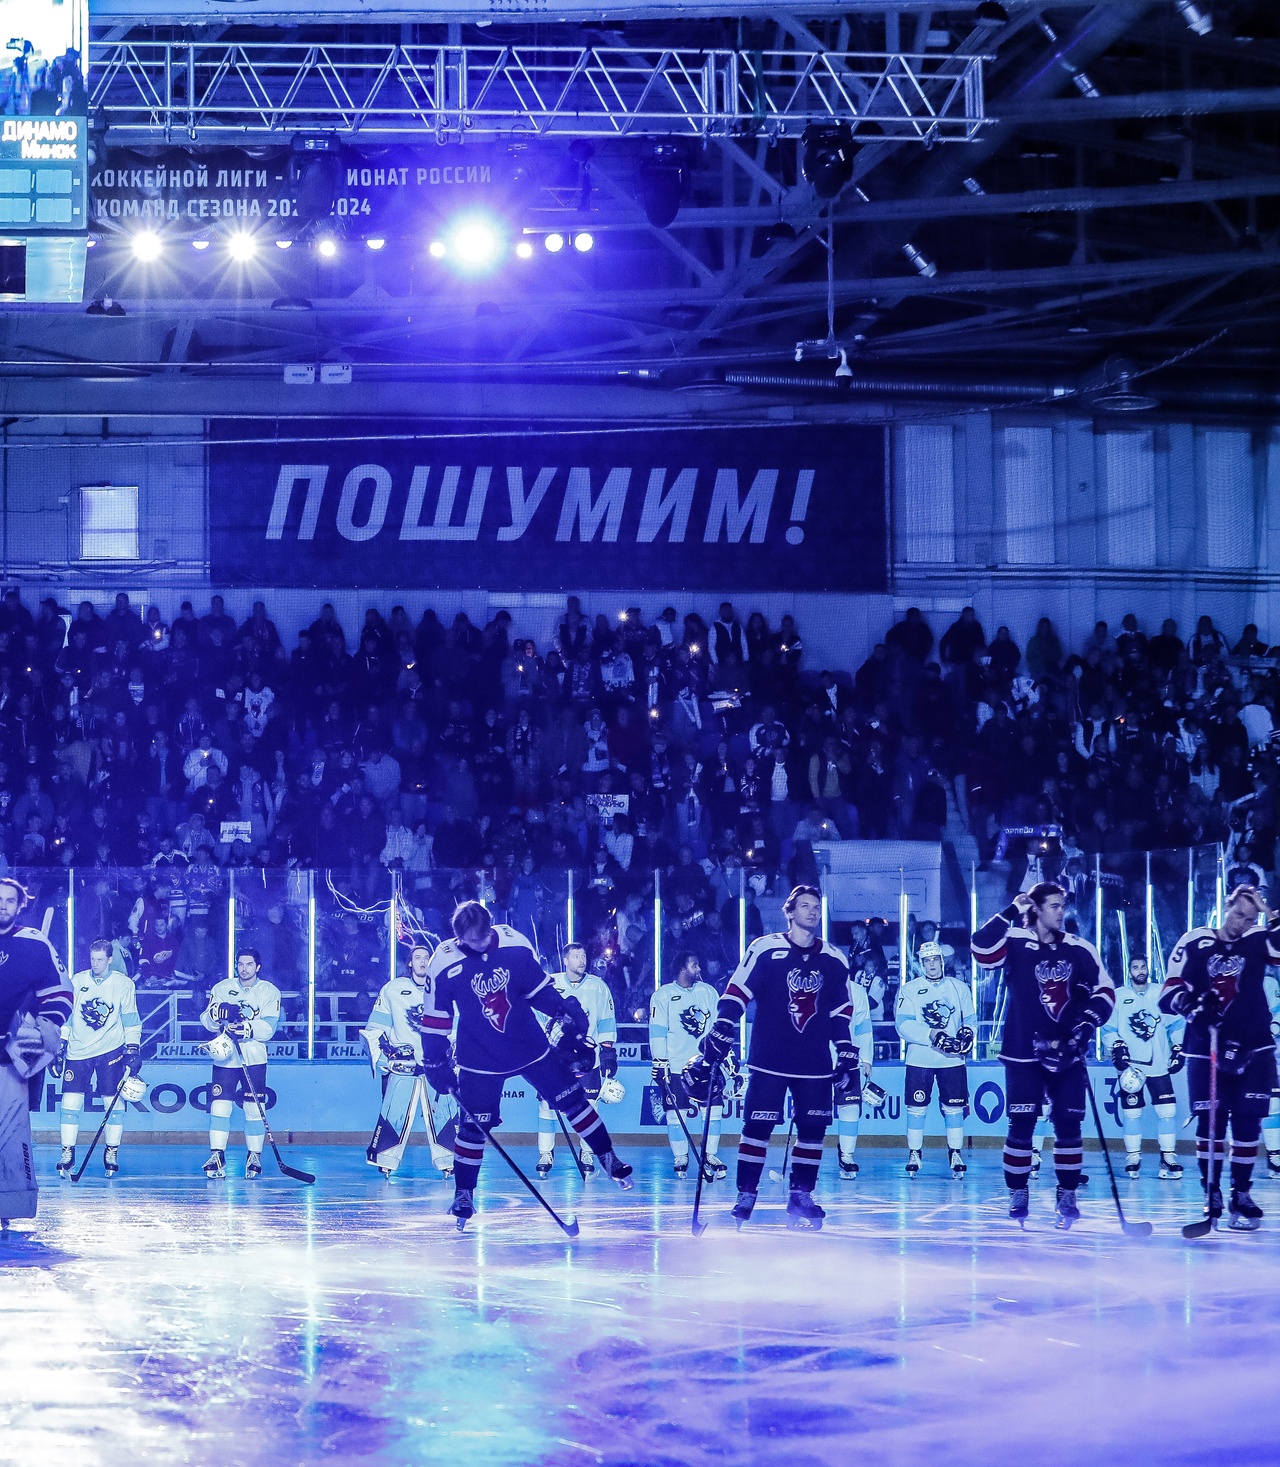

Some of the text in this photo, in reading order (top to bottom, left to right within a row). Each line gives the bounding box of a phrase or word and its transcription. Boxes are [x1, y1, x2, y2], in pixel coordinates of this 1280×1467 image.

[1, 120, 78, 142] ДИНАМО
[216, 169, 267, 188] ЛИГИ
[417, 165, 492, 185] РОССИИ
[97, 198, 179, 221] КОМАНД
[187, 198, 262, 218] СЕЗОНА
[265, 463, 815, 546] ПОШУМИМ!
[752, 1111, 779, 1120] PARI
